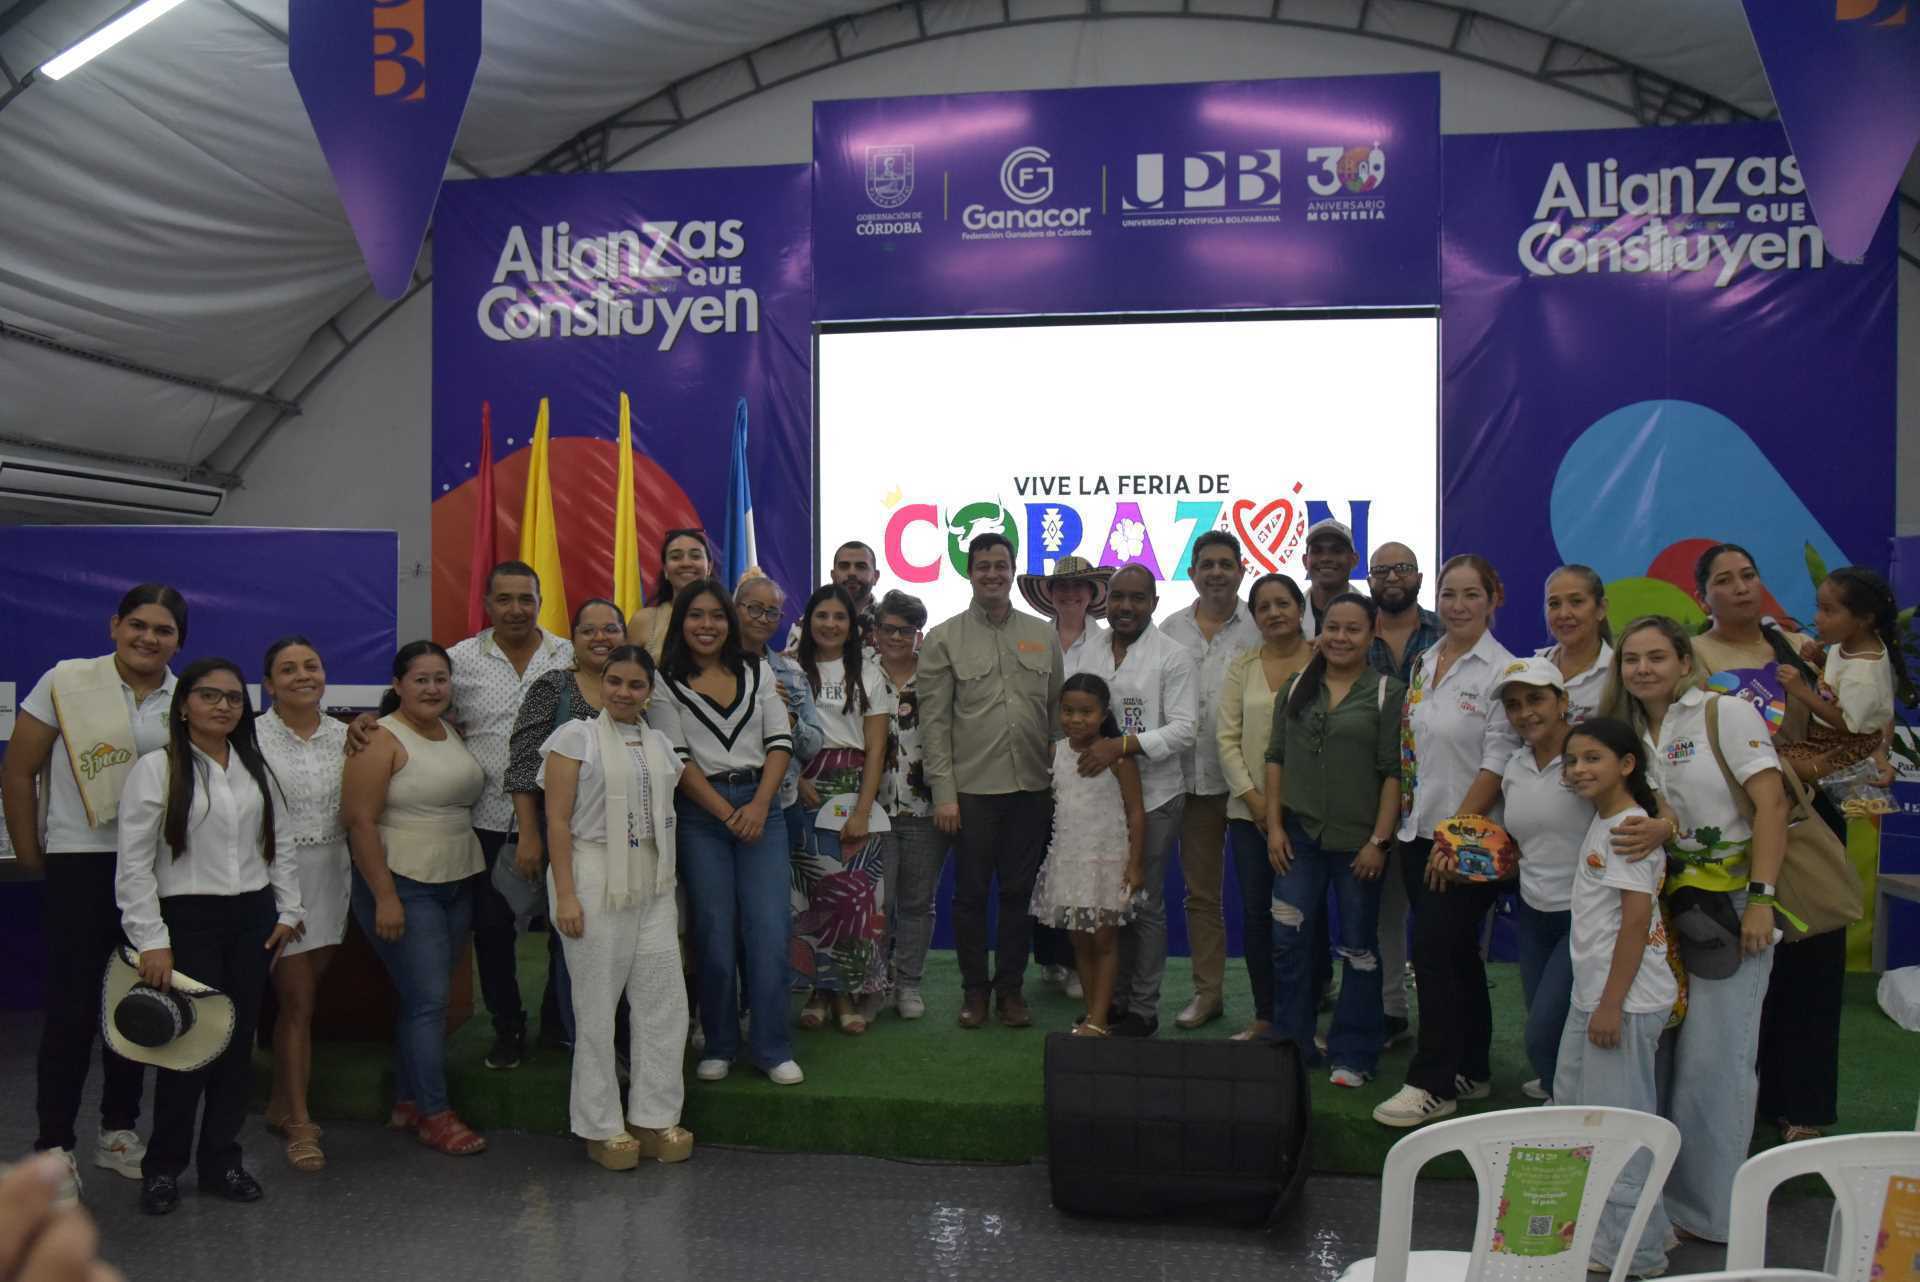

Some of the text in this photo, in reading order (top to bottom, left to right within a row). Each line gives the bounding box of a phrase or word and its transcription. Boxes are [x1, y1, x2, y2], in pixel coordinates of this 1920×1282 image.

[1122, 149, 1281, 209] UPB
[1307, 199, 1386, 211] ANIVERSARIO
[1307, 209, 1386, 221] MONTERÍA
[1746, 202, 1805, 222] QUE
[857, 212, 910, 222] GOBERNACIÓN
[962, 204, 1091, 230] Ganacor
[1122, 215, 1280, 227] UNIVERSIDAD PONTIFICIA BOLIVARIANA
[856, 220, 922, 236] CÓRDOBA
[962, 230, 1003, 240] Federación
[1005, 229, 1044, 239] Ganadera
[1057, 228, 1092, 237] Córdoba
[1518, 217, 1824, 288] Construyen
[687, 266, 742, 286] QUE
[477, 281, 759, 351] Construyen
[1014, 474, 1230, 496] VIVE LA FERIA DE
